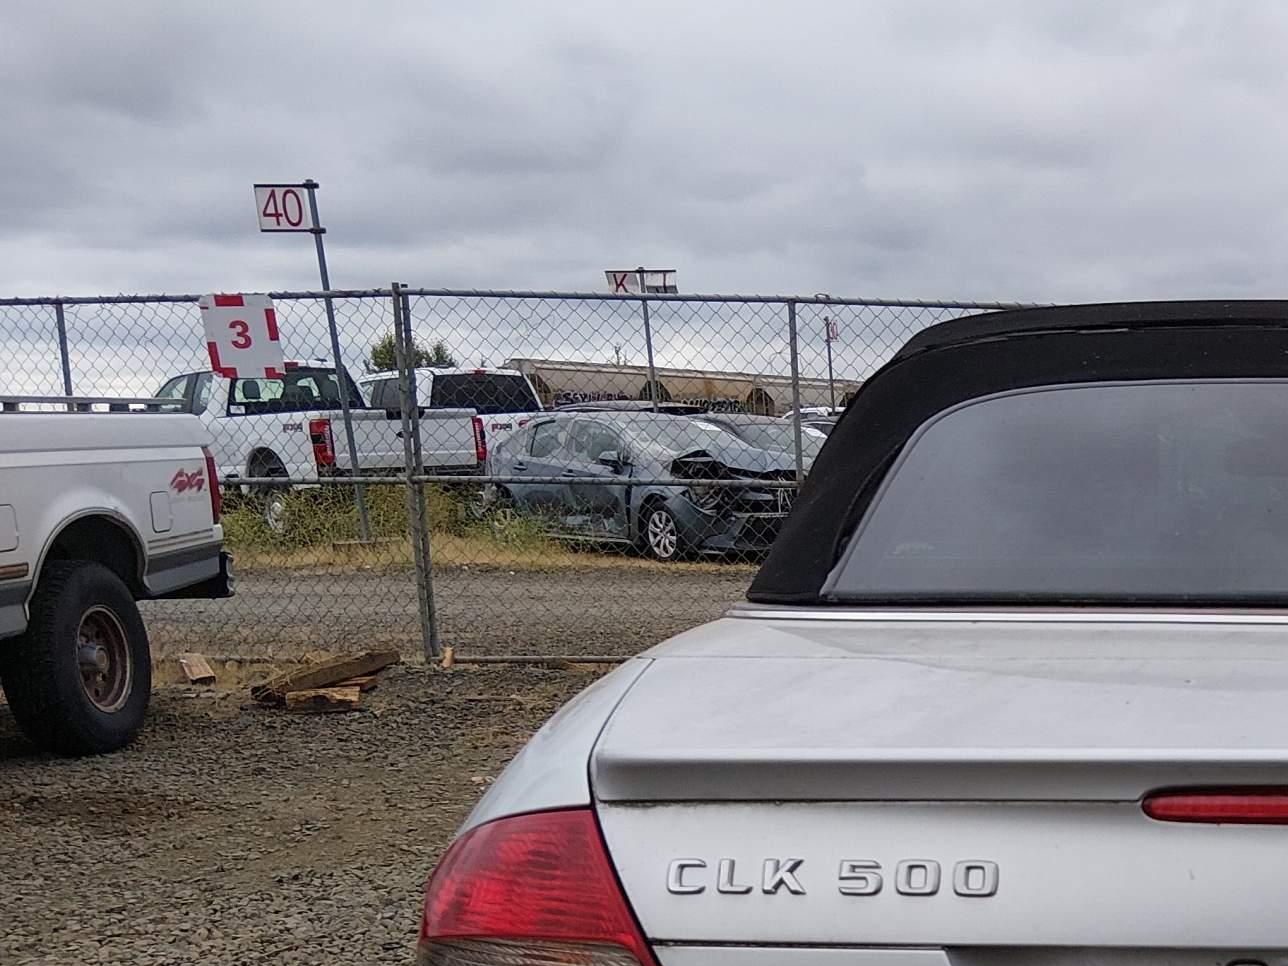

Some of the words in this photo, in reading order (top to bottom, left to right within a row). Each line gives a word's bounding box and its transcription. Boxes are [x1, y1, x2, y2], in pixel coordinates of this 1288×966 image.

[263, 189, 303, 227] 40
[613, 273, 629, 293] K
[229, 320, 252, 349] 3
[666, 858, 806, 895] CLK
[838, 858, 999, 897] 500
